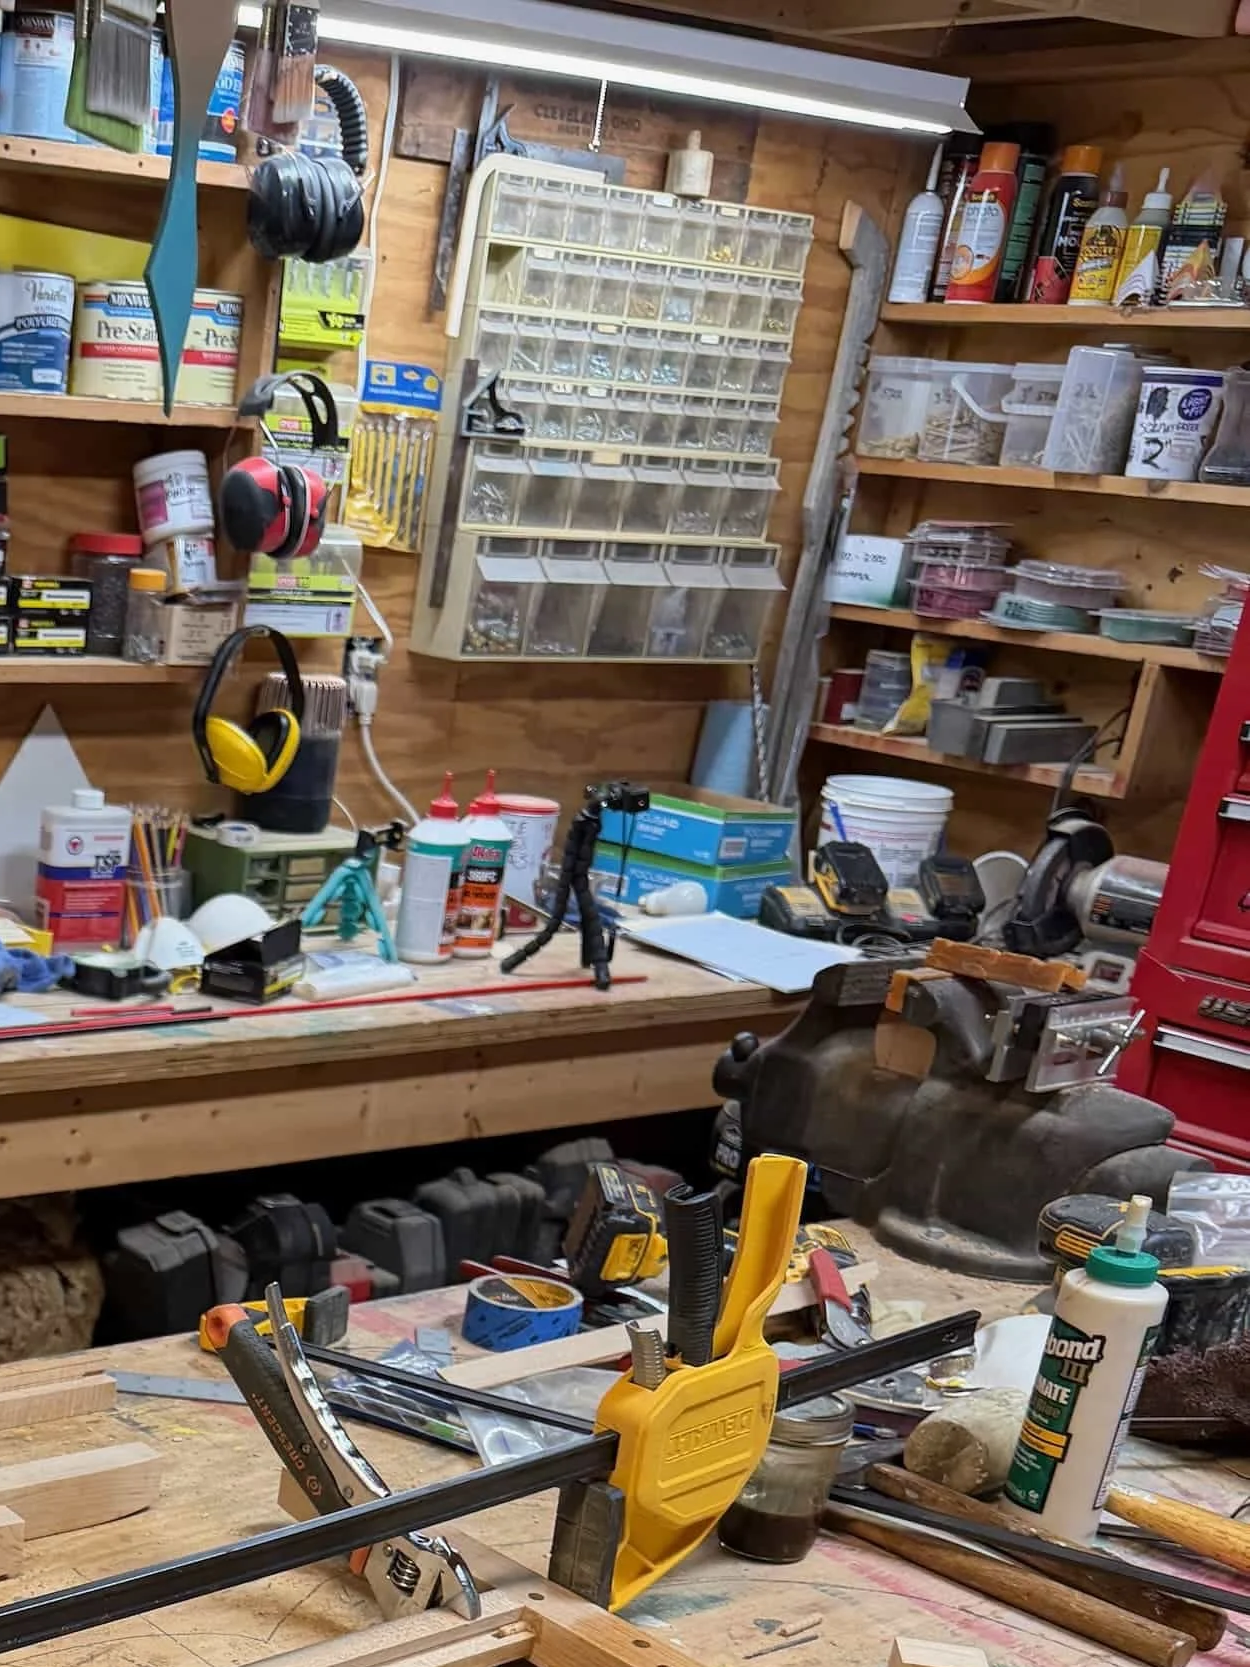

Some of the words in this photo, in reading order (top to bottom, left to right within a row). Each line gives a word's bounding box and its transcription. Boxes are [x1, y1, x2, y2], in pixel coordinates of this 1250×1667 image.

[93, 855, 122, 873] TSP
[1061, 1359, 1090, 1386] III
[253, 1396, 306, 1471] CRESCENT
